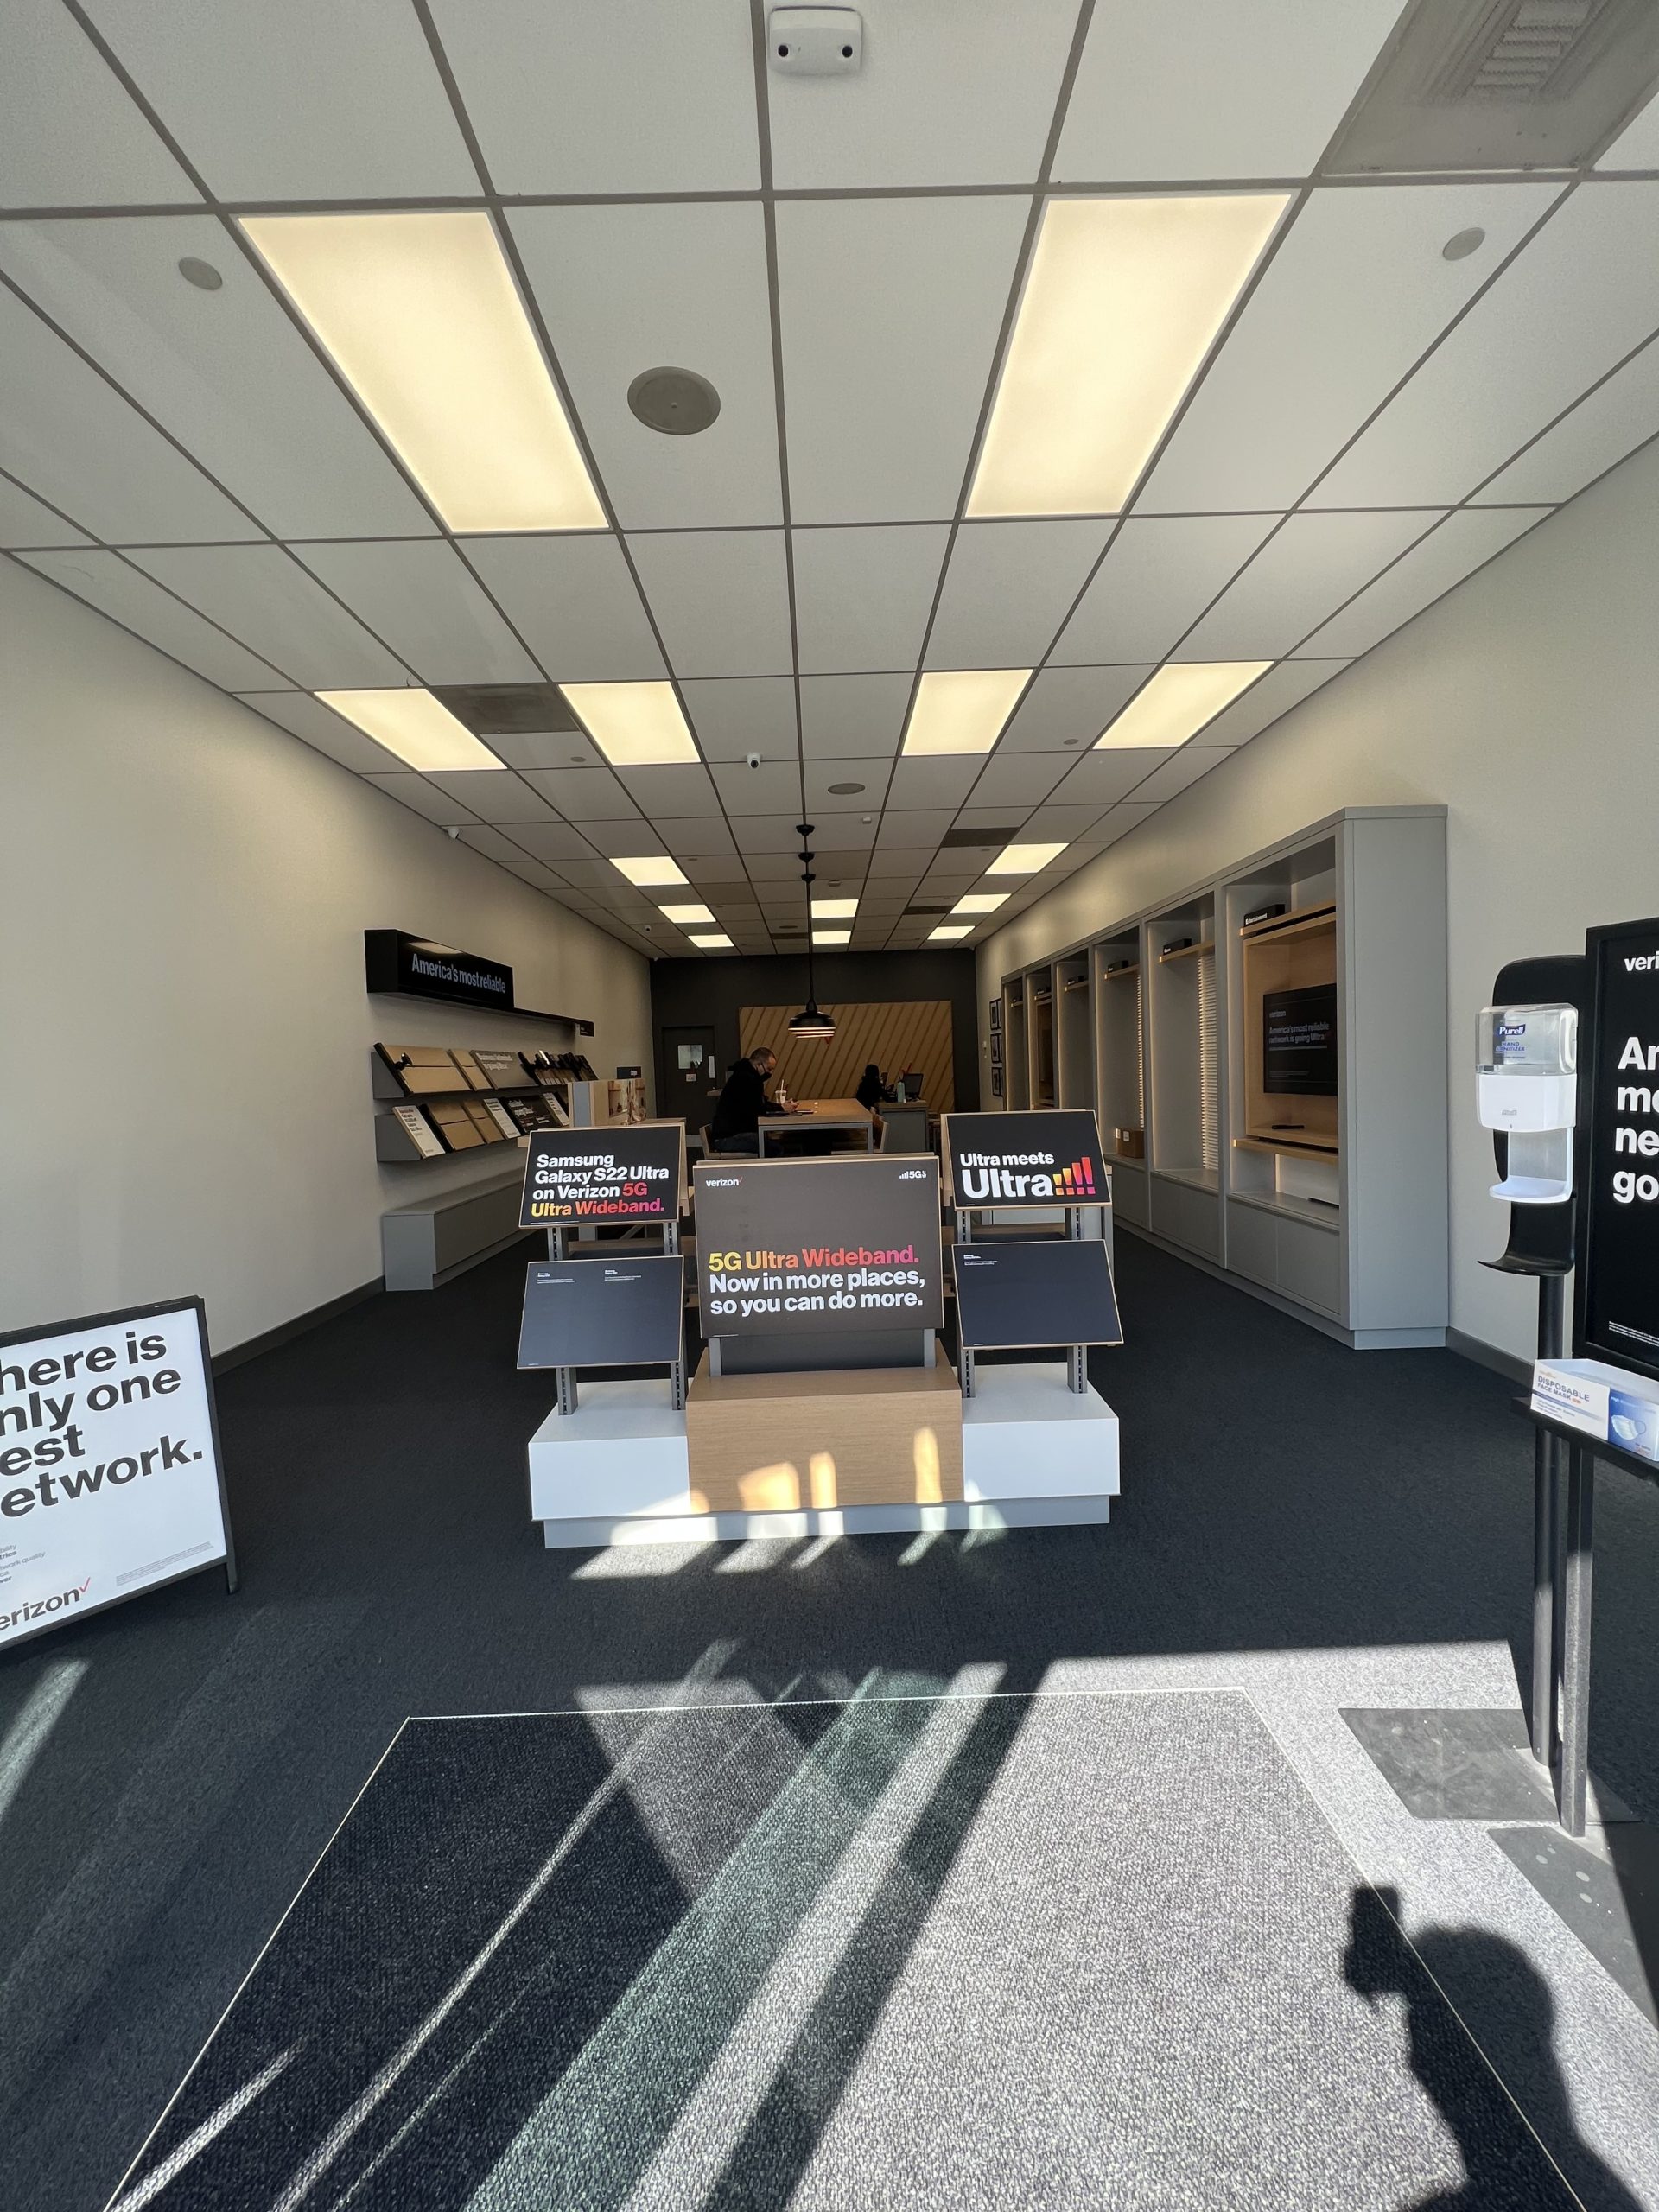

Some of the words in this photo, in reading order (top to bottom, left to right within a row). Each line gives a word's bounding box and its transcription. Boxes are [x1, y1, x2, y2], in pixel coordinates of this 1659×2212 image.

[411, 953, 458, 982] America's
[459, 969, 480, 988] most
[480, 974, 506, 994] reliable
[536, 1154, 614, 1168] Samsung
[960, 1153, 1001, 1167] Ultra
[1002, 1151, 1055, 1166] meets
[534, 1169, 592, 1185] Galaxy
[594, 1166, 628, 1182] S22
[630, 1166, 670, 1179] Ultra
[705, 1178, 740, 1187] verizon
[532, 1188, 555, 1200] on
[556, 1185, 620, 1199] Verizon
[622, 1182, 648, 1197] 5G
[531, 1202, 571, 1217] Ultra
[575, 1198, 664, 1216] Wideband.
[709, 1251, 742, 1272] 5G
[745, 1250, 798, 1270] Ultra
[801, 1244, 919, 1268] Wideband.
[709, 1274, 760, 1293] Now
[763, 1272, 783, 1291] in
[785, 1274, 844, 1290] more
[847, 1268, 925, 1291] places,
[710, 1299, 737, 1315] so
[741, 1297, 781, 1317] you
[784, 1295, 824, 1311] can
[828, 1291, 857, 1309] do
[860, 1292, 923, 1308] more.
[125, 1331, 167, 1364] is
[86, 1368, 181, 1411] one
[1537, 1375, 1590, 1402] DISPOSABLE
[1537, 1382, 1553, 1393] FACE
[1553, 1389, 1572, 1401] MASK
